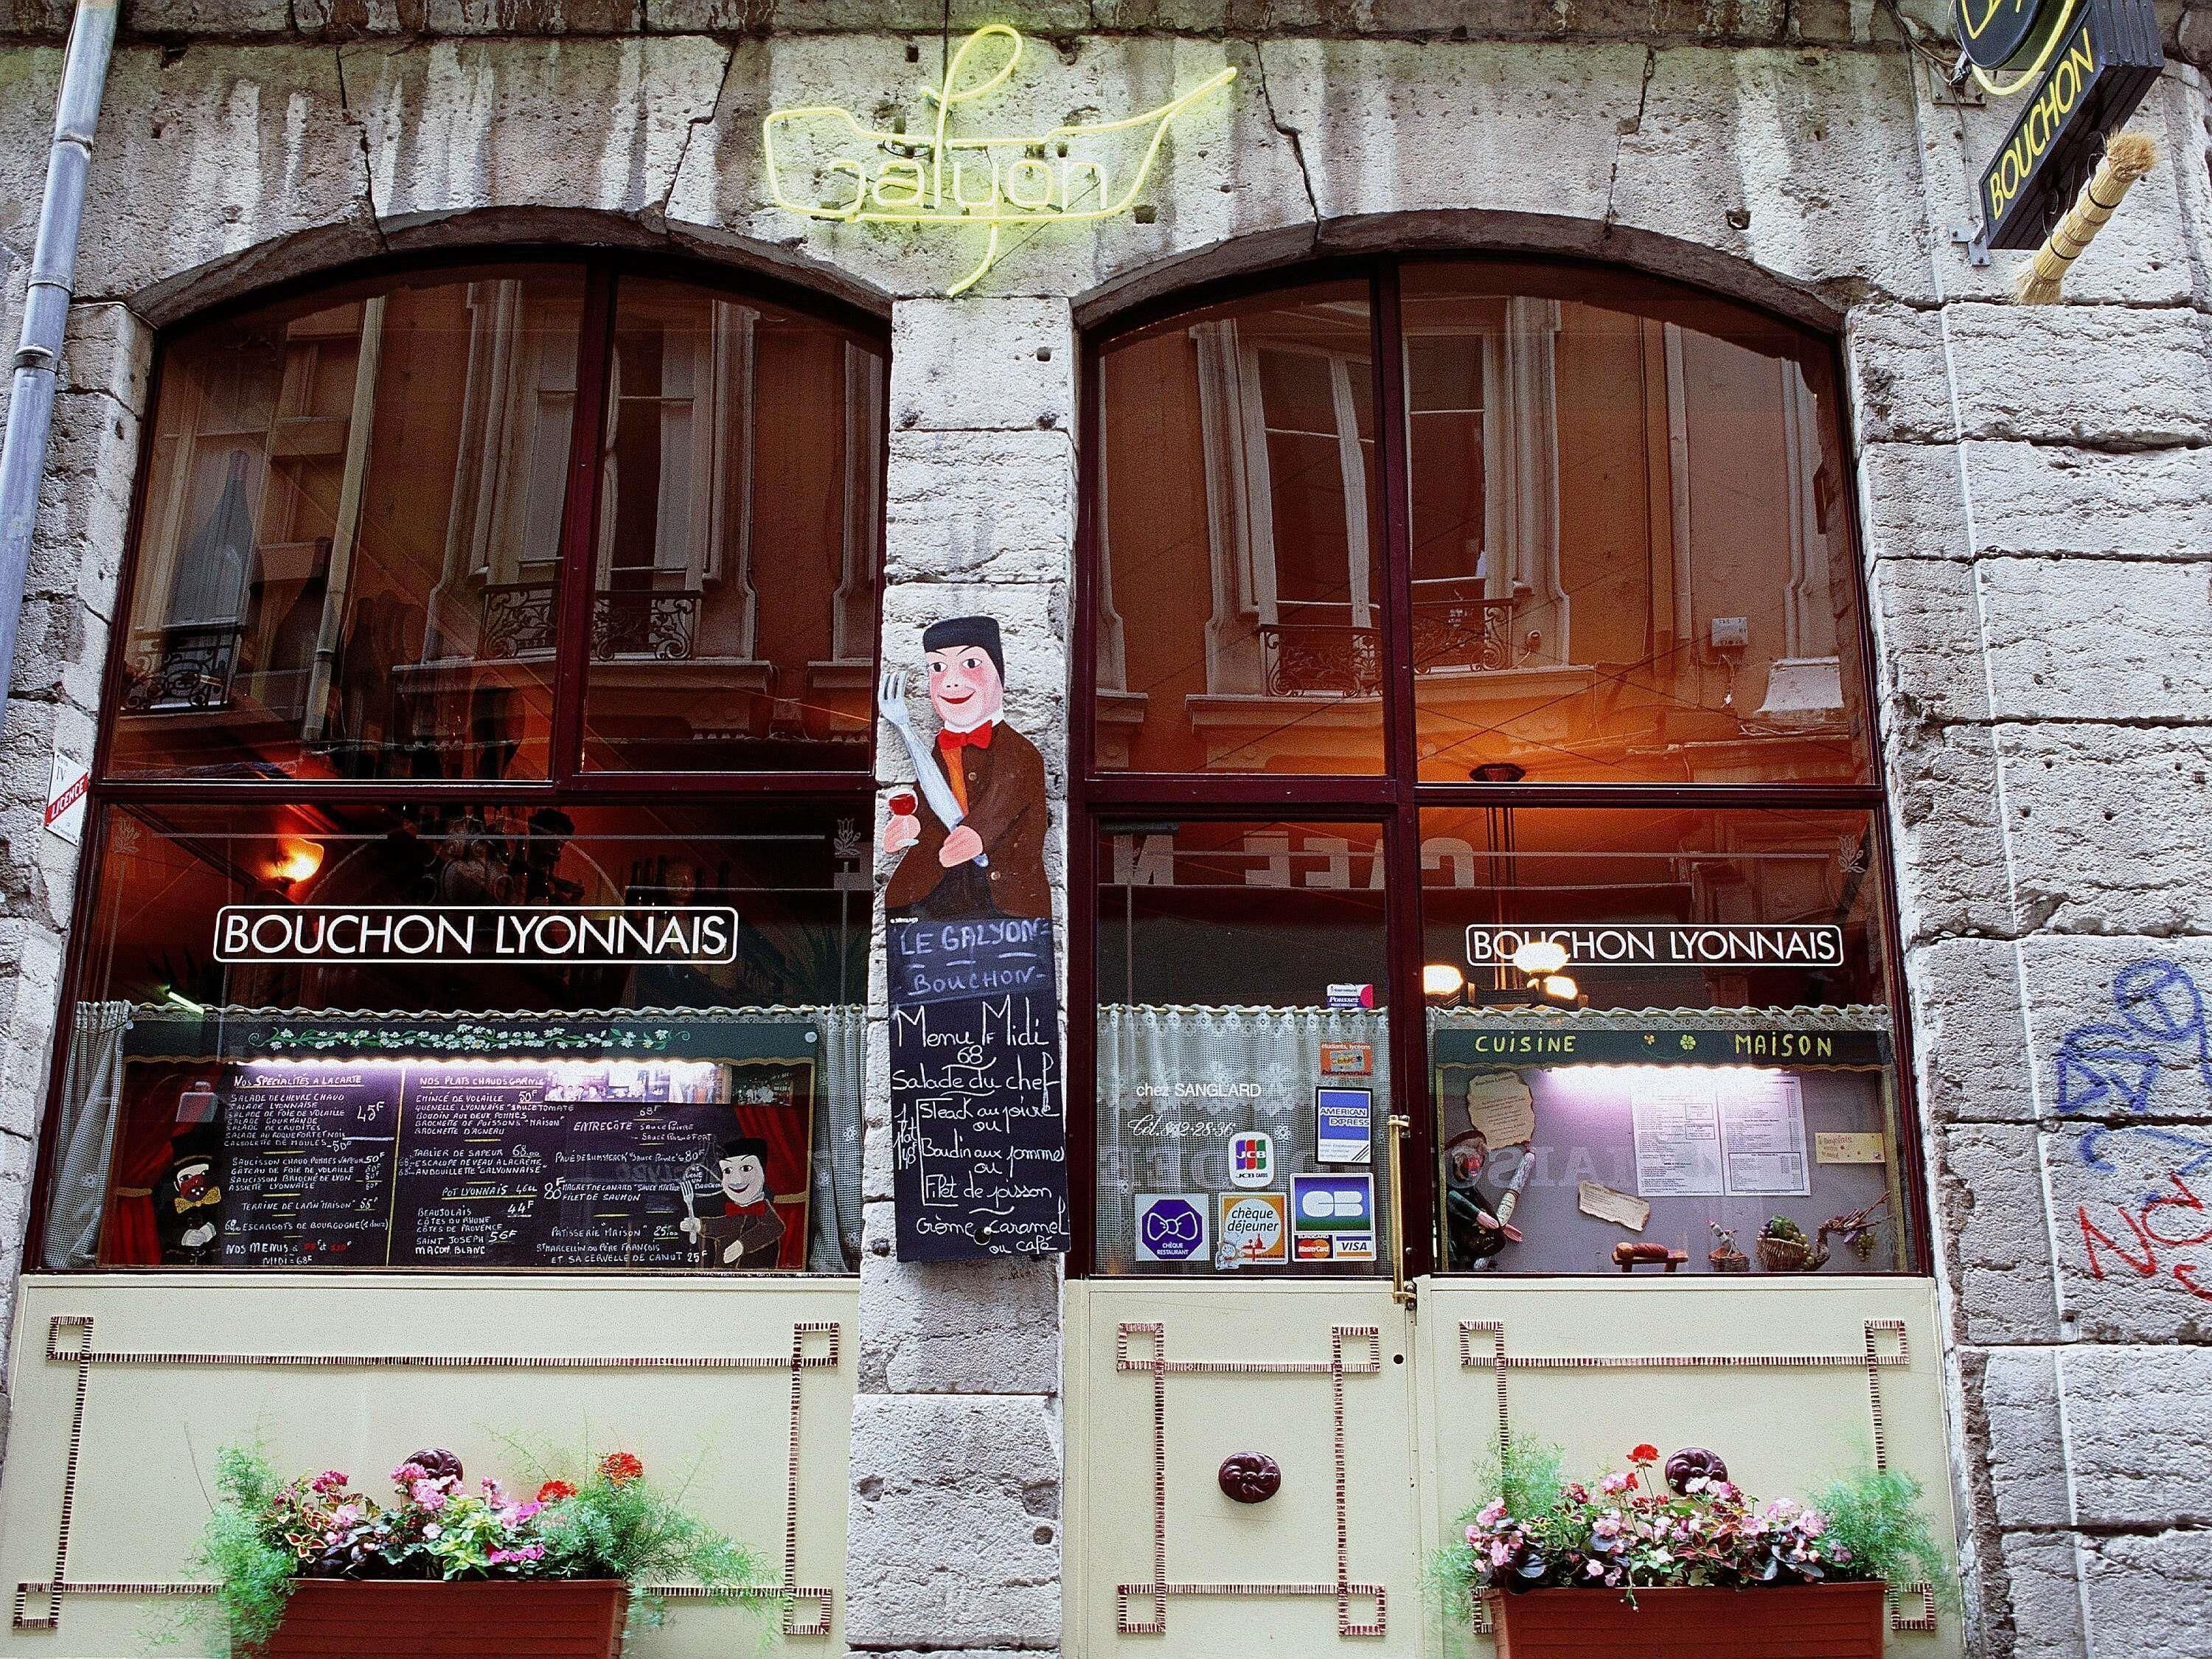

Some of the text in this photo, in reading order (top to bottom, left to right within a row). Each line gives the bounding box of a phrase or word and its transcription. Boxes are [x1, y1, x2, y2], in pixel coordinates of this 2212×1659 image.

[1989, 28, 2093, 220] BOUCHON
[50, 778, 84, 818] LICENCE
[224, 914, 727, 955] BOUCHON LYONNAIS
[900, 919, 1041, 956] LE GALYON
[1670, 931, 1836, 960] LYONNAIS
[908, 967, 1036, 995] BOUCHON
[893, 994, 1049, 1047] Menu Midi
[1475, 1031, 1832, 1058] CUISINE MAISON
[334, 1075, 362, 1084] CARTE
[420, 1077, 440, 1085] NOS
[445, 1077, 470, 1085] PLATS
[891, 1051, 1062, 1108] Salade du chef
[1136, 1083, 1262, 1097] chez SANGLARD
[230, 1093, 266, 1102] SALADE
[466, 1093, 504, 1102] VOLAILLE
[229, 1101, 319, 1110] SALADE LYONNAISE
[976, 1106, 999, 1115] au
[227, 1110, 261, 1118] SALADE
[416, 1111, 449, 1119] BOUDIN
[973, 1121, 1002, 1132] ou
[1330, 1118, 1369, 1126] EXPRESS
[291, 1138, 327, 1147] MOULES
[922, 1128, 971, 1158] Boudin
[974, 1147, 1002, 1158] aux
[414, 1147, 449, 1157] TABLIER
[468, 1149, 503, 1157] SAPEUR
[1236, 1151, 1266, 1159] JCB
[232, 1155, 280, 1166] SAUCISSON
[415, 1158, 457, 1166] ESCALOPE
[973, 1162, 1003, 1174] ou
[230, 1175, 277, 1183] SAUCISSON
[229, 1181, 316, 1192] ASSIETTE LYONNAISE
[963, 1170, 984, 1199] de
[442, 1183, 508, 1197] POT LYONNAIS
[563, 1192, 585, 1201] FILET
[602, 1193, 641, 1202] SAUMON
[242, 1200, 279, 1211] TERRINE
[418, 1204, 472, 1217] BEAUJOLAIS
[1231, 1207, 1273, 1221] chèque
[242, 1222, 293, 1231] ESCARGOTS
[310, 1222, 360, 1230] BOURGOGNE
[462, 1224, 503, 1232] PROVENCE
[1227, 1220, 1279, 1234] déjeuner
[417, 1236, 444, 1245] SAINT
[448, 1236, 484, 1244] JOSEPH
[226, 1242, 288, 1254] NOS MENUS
[454, 1246, 485, 1254] BLANC
[989, 1245, 1012, 1253] ou
[1298, 1245, 1329, 1253] MasterCard
[1341, 1242, 1368, 1251] VISA
[632, 1253, 646, 1262] DE
